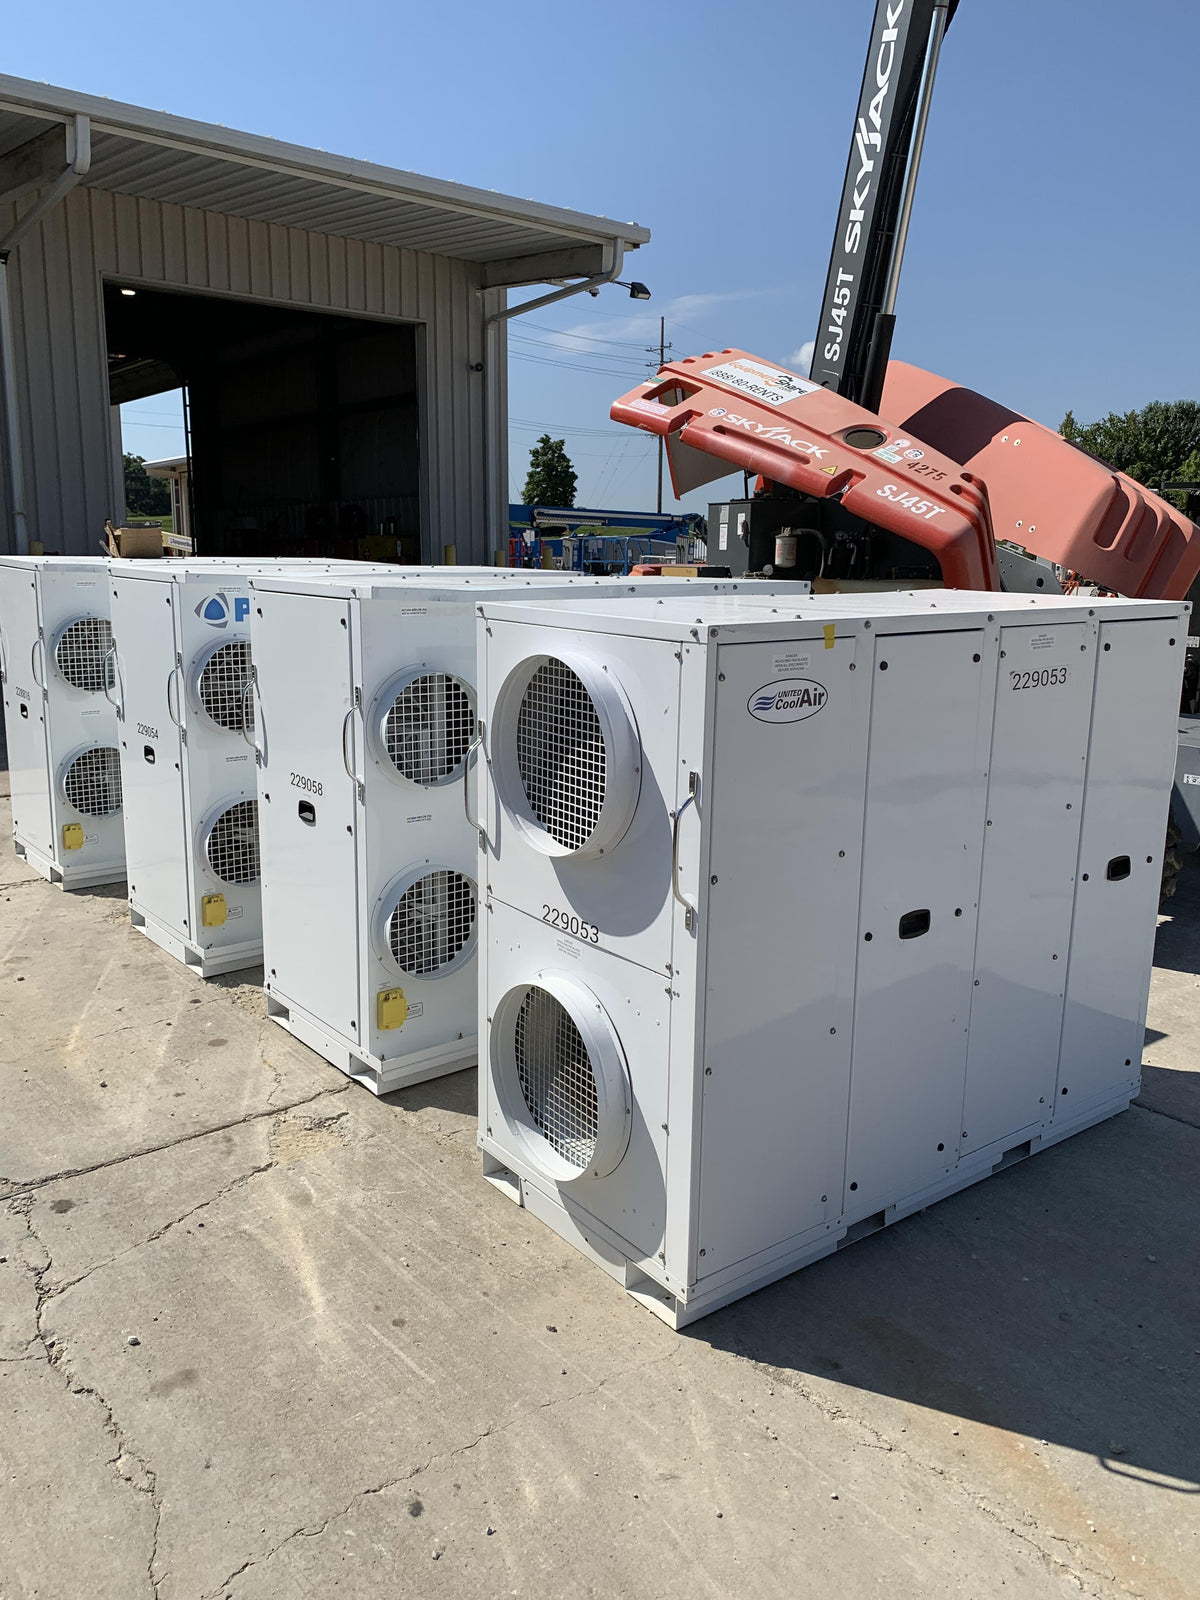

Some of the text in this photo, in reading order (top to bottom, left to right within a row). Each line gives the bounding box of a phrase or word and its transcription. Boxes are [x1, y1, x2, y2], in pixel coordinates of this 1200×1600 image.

[844, 0, 904, 253] SKYJACK
[823, 267, 854, 362] SJ45T
[732, 379, 784, 401] 80-RENTS
[723, 414, 830, 459] SKYJACK
[907, 462, 948, 481] 4275
[876, 485, 946, 519] SJ45T
[1012, 668, 1067, 690] 229053
[777, 689, 802, 698] UNITED
[137, 722, 159, 739] 229054
[290, 772, 323, 796] 229058
[542, 904, 599, 944] 229053
